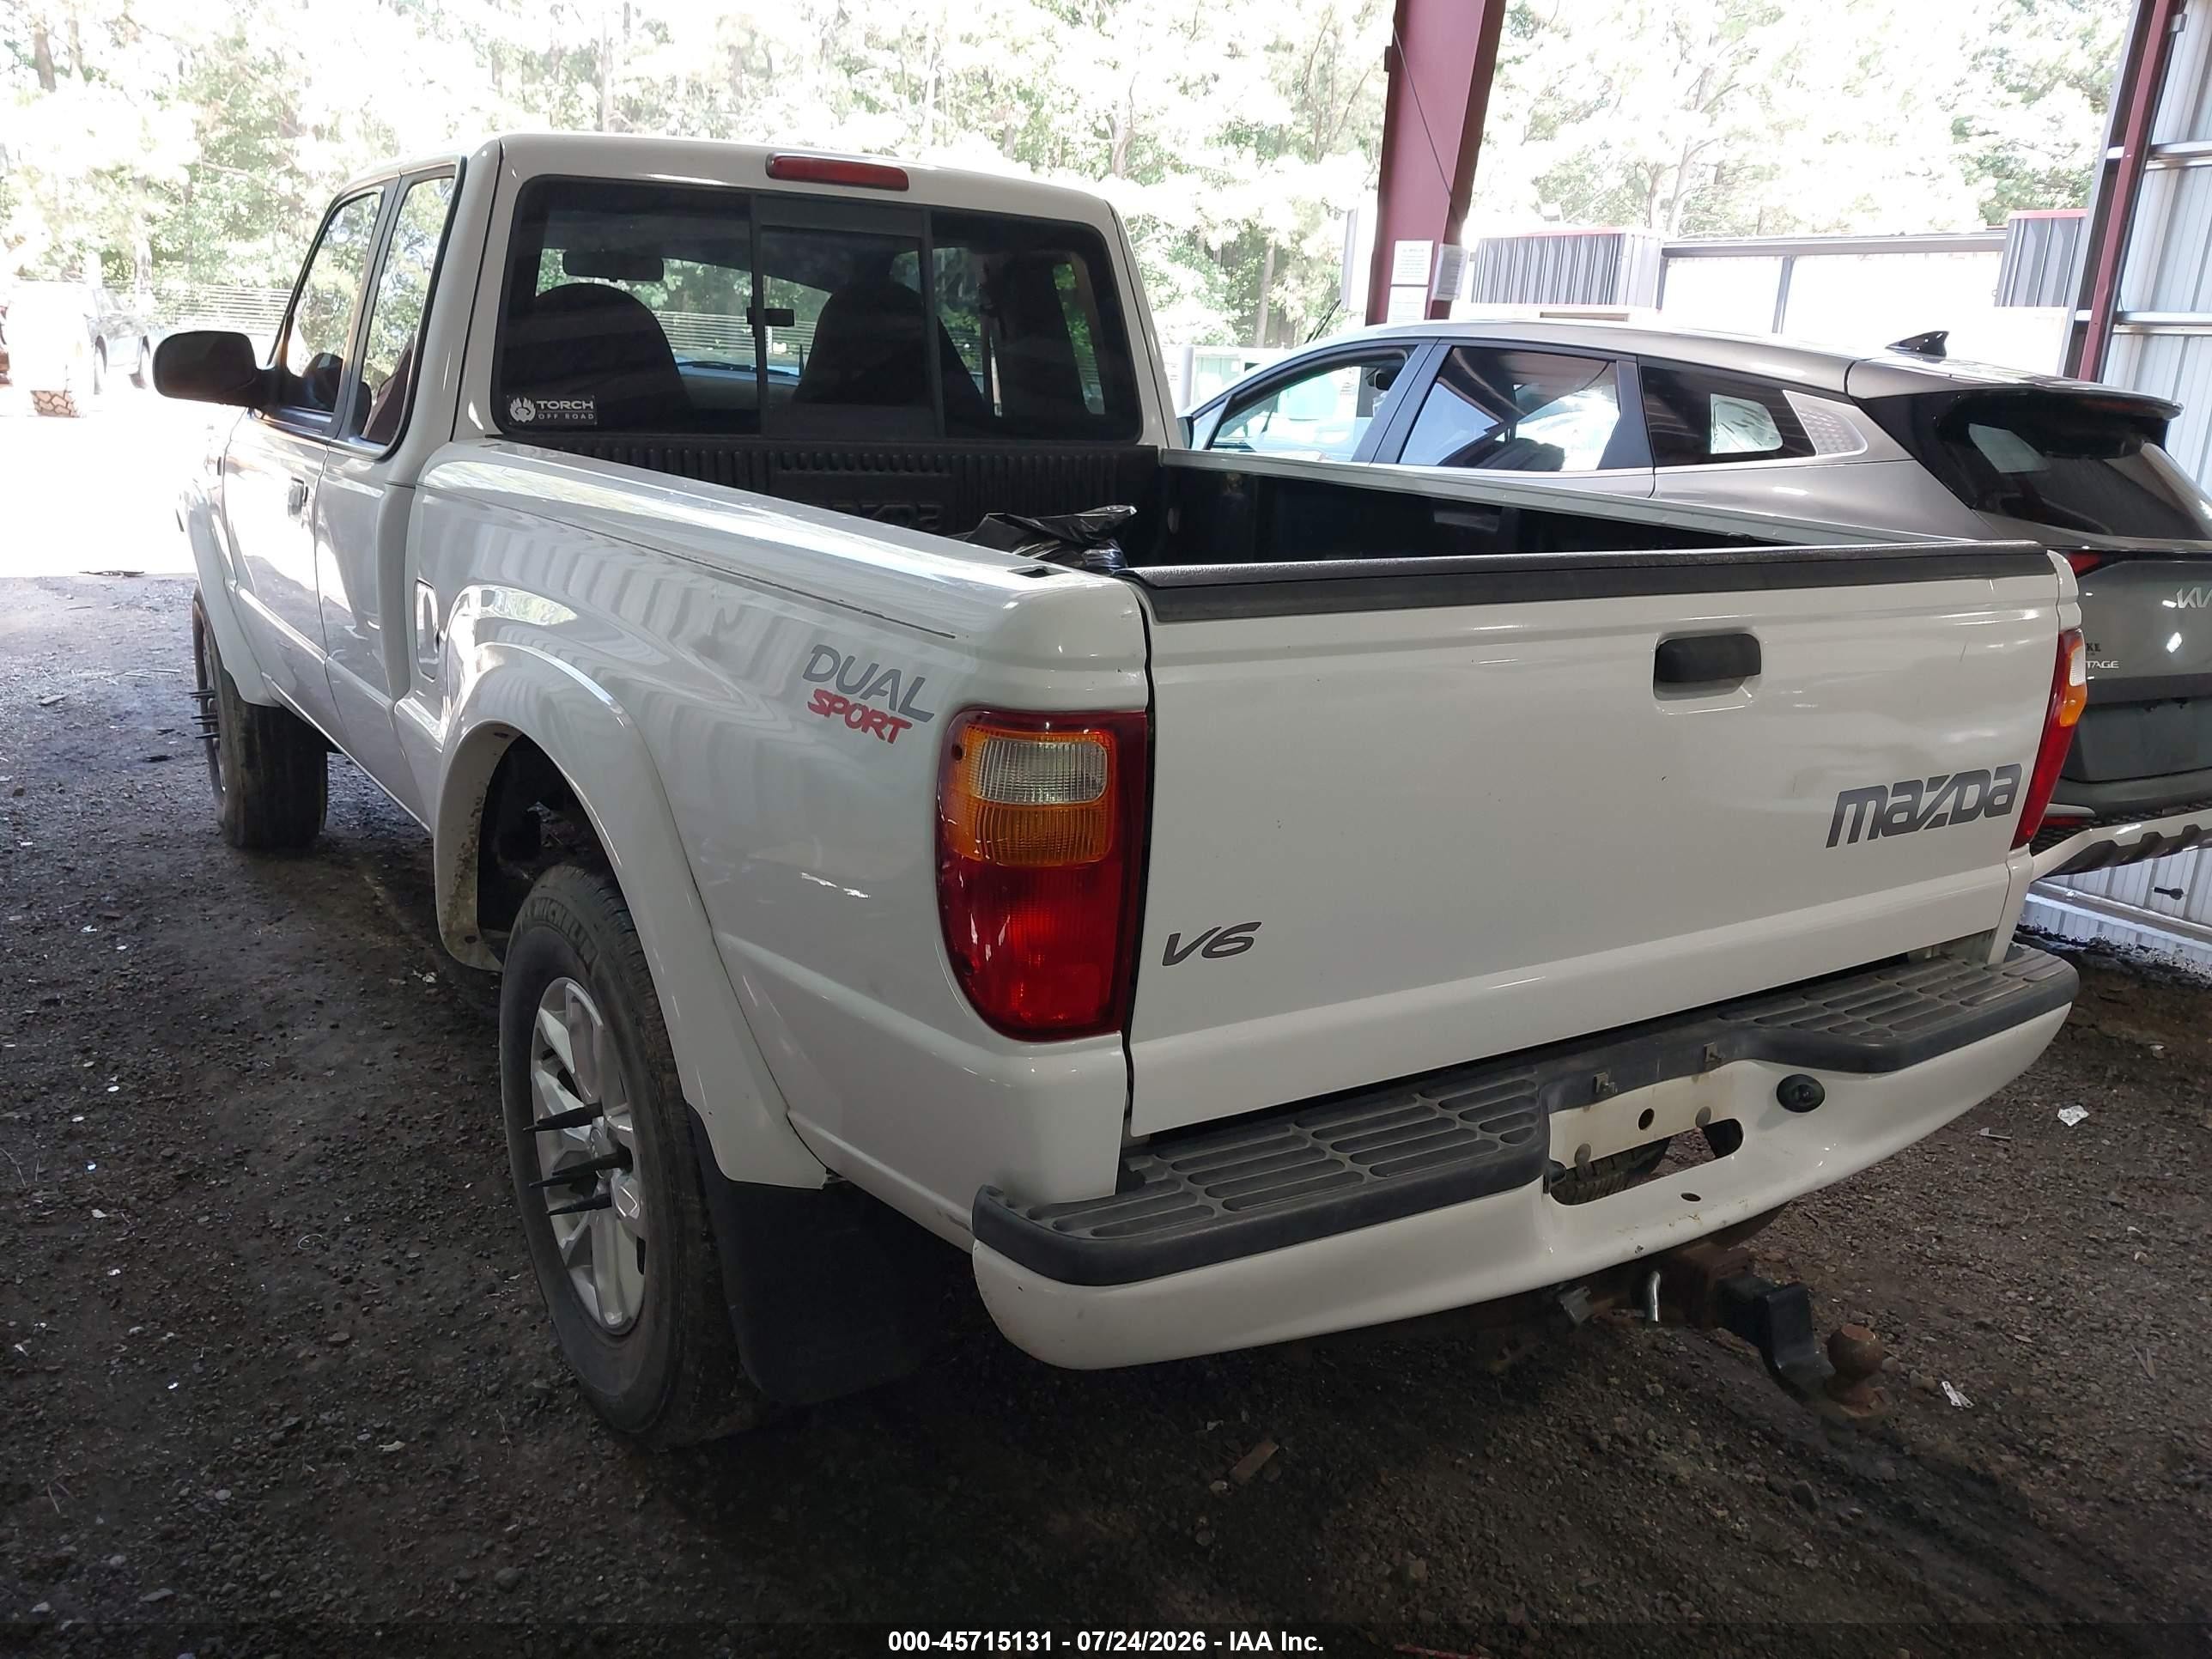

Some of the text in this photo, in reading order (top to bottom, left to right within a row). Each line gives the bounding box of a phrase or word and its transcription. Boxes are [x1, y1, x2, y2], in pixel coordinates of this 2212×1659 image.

[536, 400, 593, 410] TORCH
[802, 644, 935, 723] DUAL
[2086, 660, 2119, 669] TAGE
[807, 688, 914, 744] SPORT
[1162, 921, 1262, 966] V6
